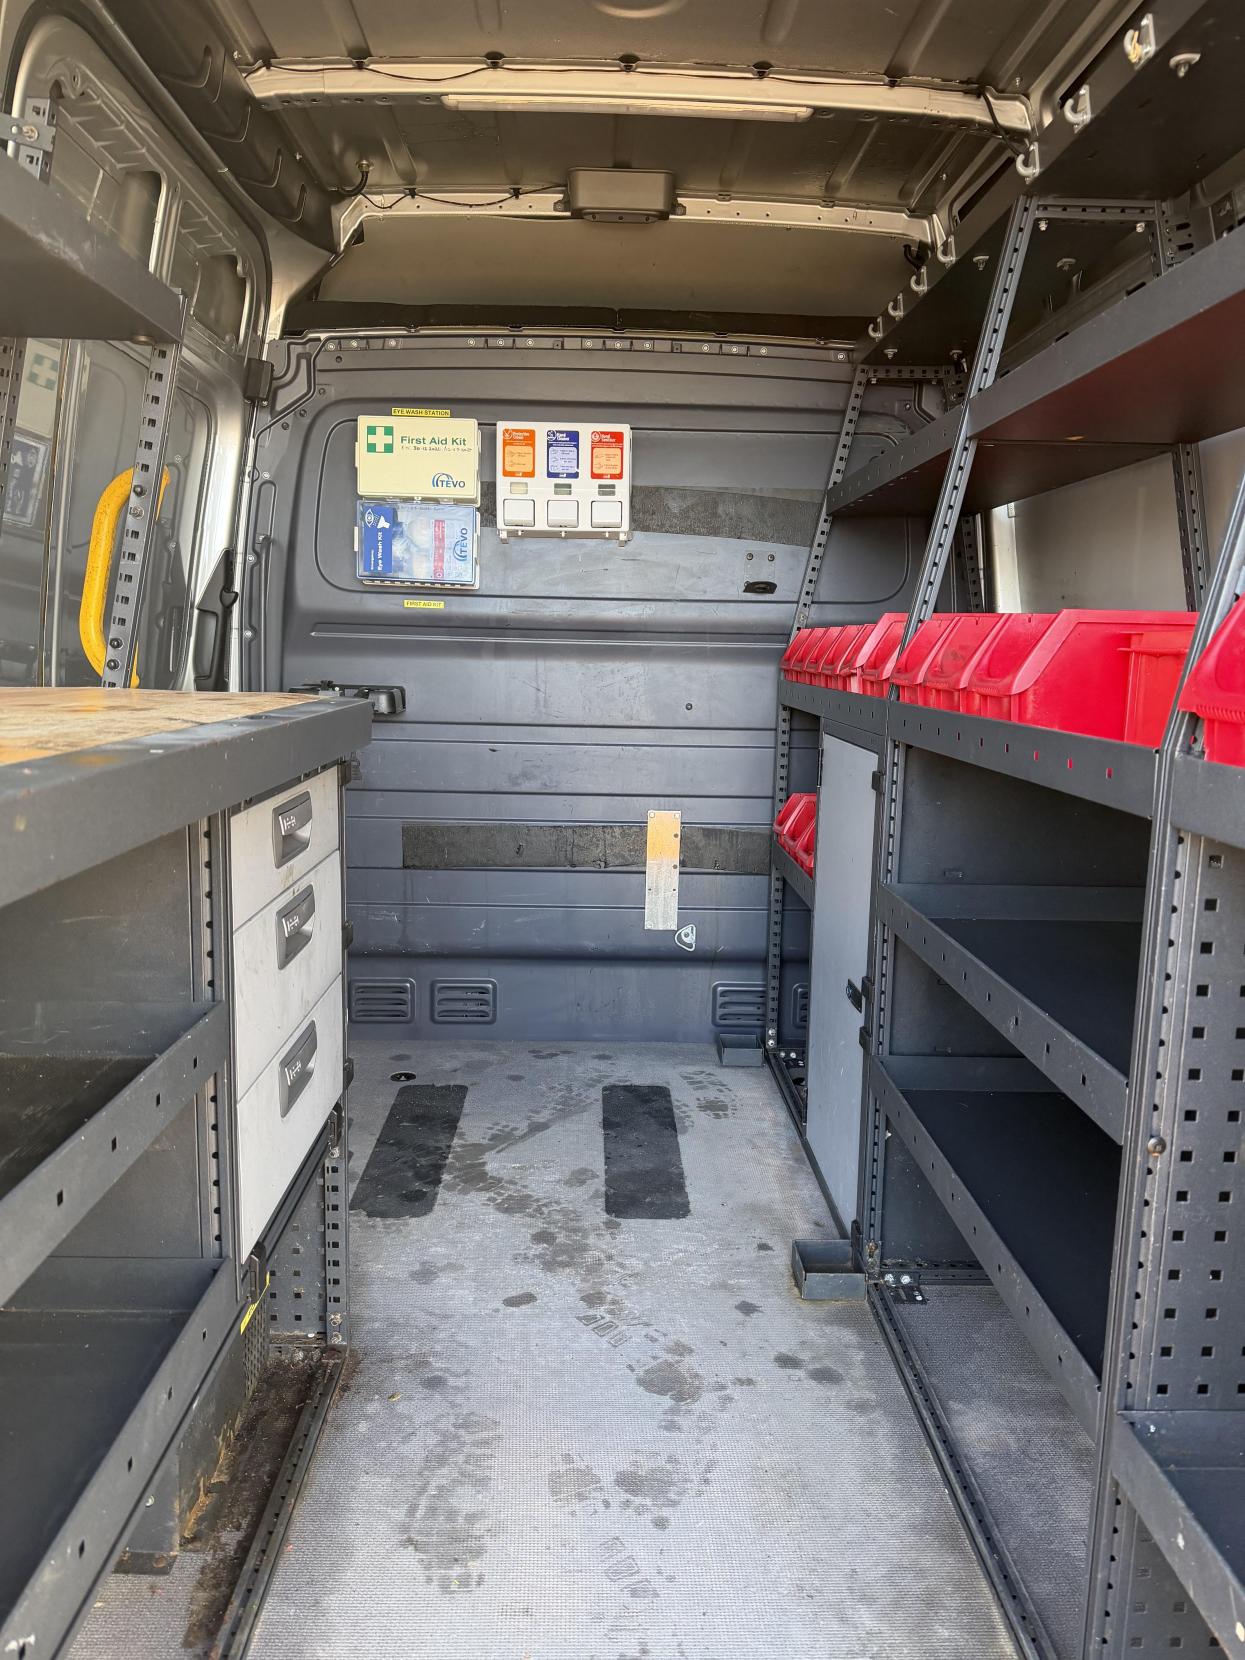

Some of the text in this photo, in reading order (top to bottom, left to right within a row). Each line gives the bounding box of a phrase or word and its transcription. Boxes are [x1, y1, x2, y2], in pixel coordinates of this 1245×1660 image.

[401, 436, 467, 446] First Aid Kit
[440, 480, 465, 488] TEVO
[460, 528, 468, 557] TEVO
